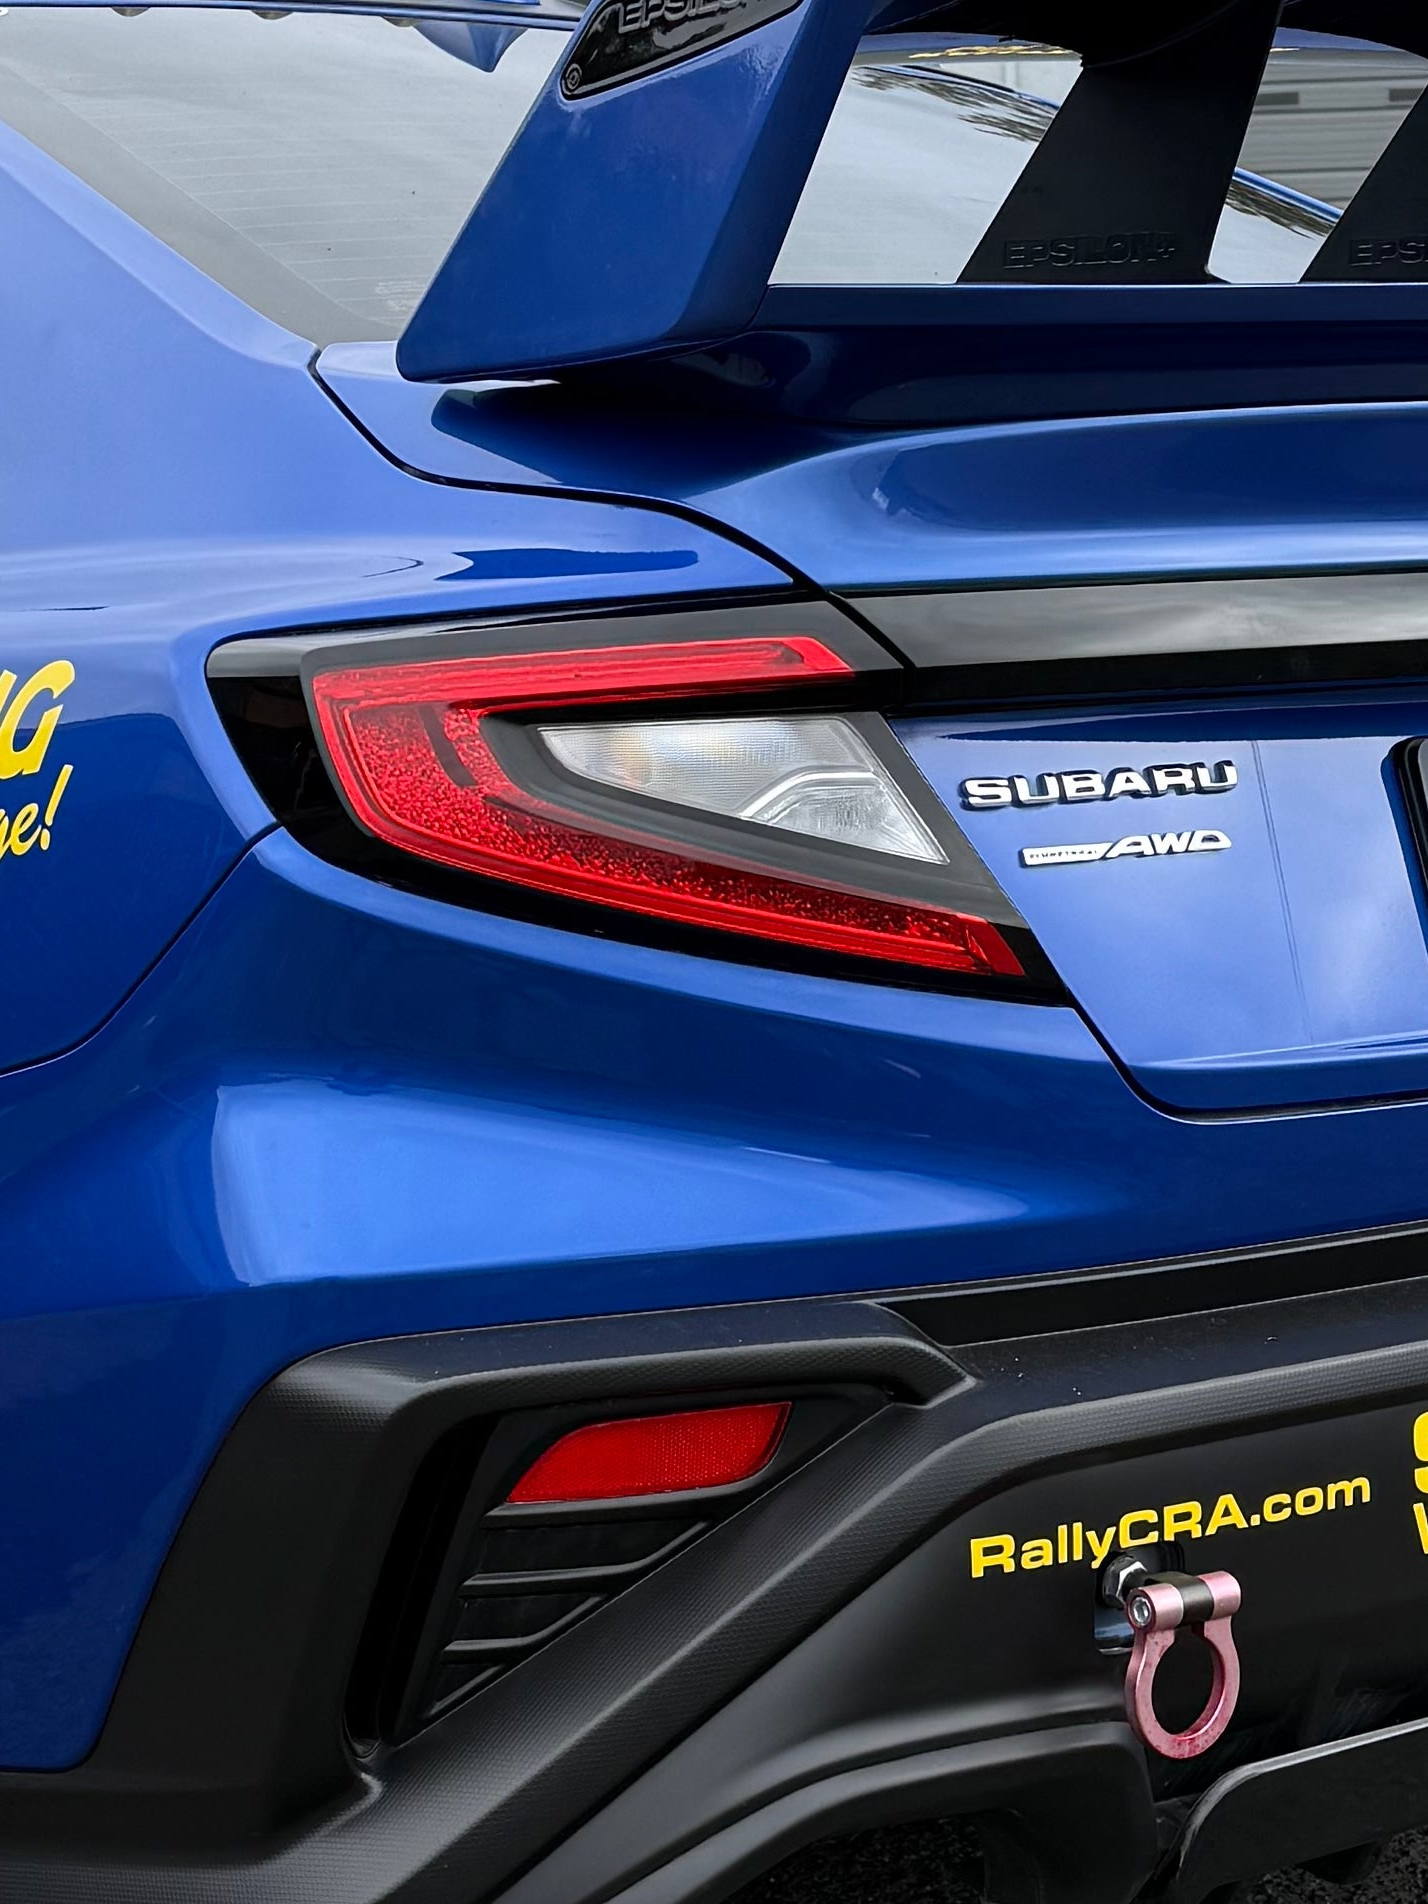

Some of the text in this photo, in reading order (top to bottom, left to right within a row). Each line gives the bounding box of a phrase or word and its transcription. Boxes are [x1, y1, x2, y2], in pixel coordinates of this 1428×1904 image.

[1003, 230, 1177, 270] EPSILON+
[960, 760, 1239, 810] SUBARU
[1102, 829, 1233, 859] AWD
[970, 1475, 1371, 1579] RallyCRA.com
